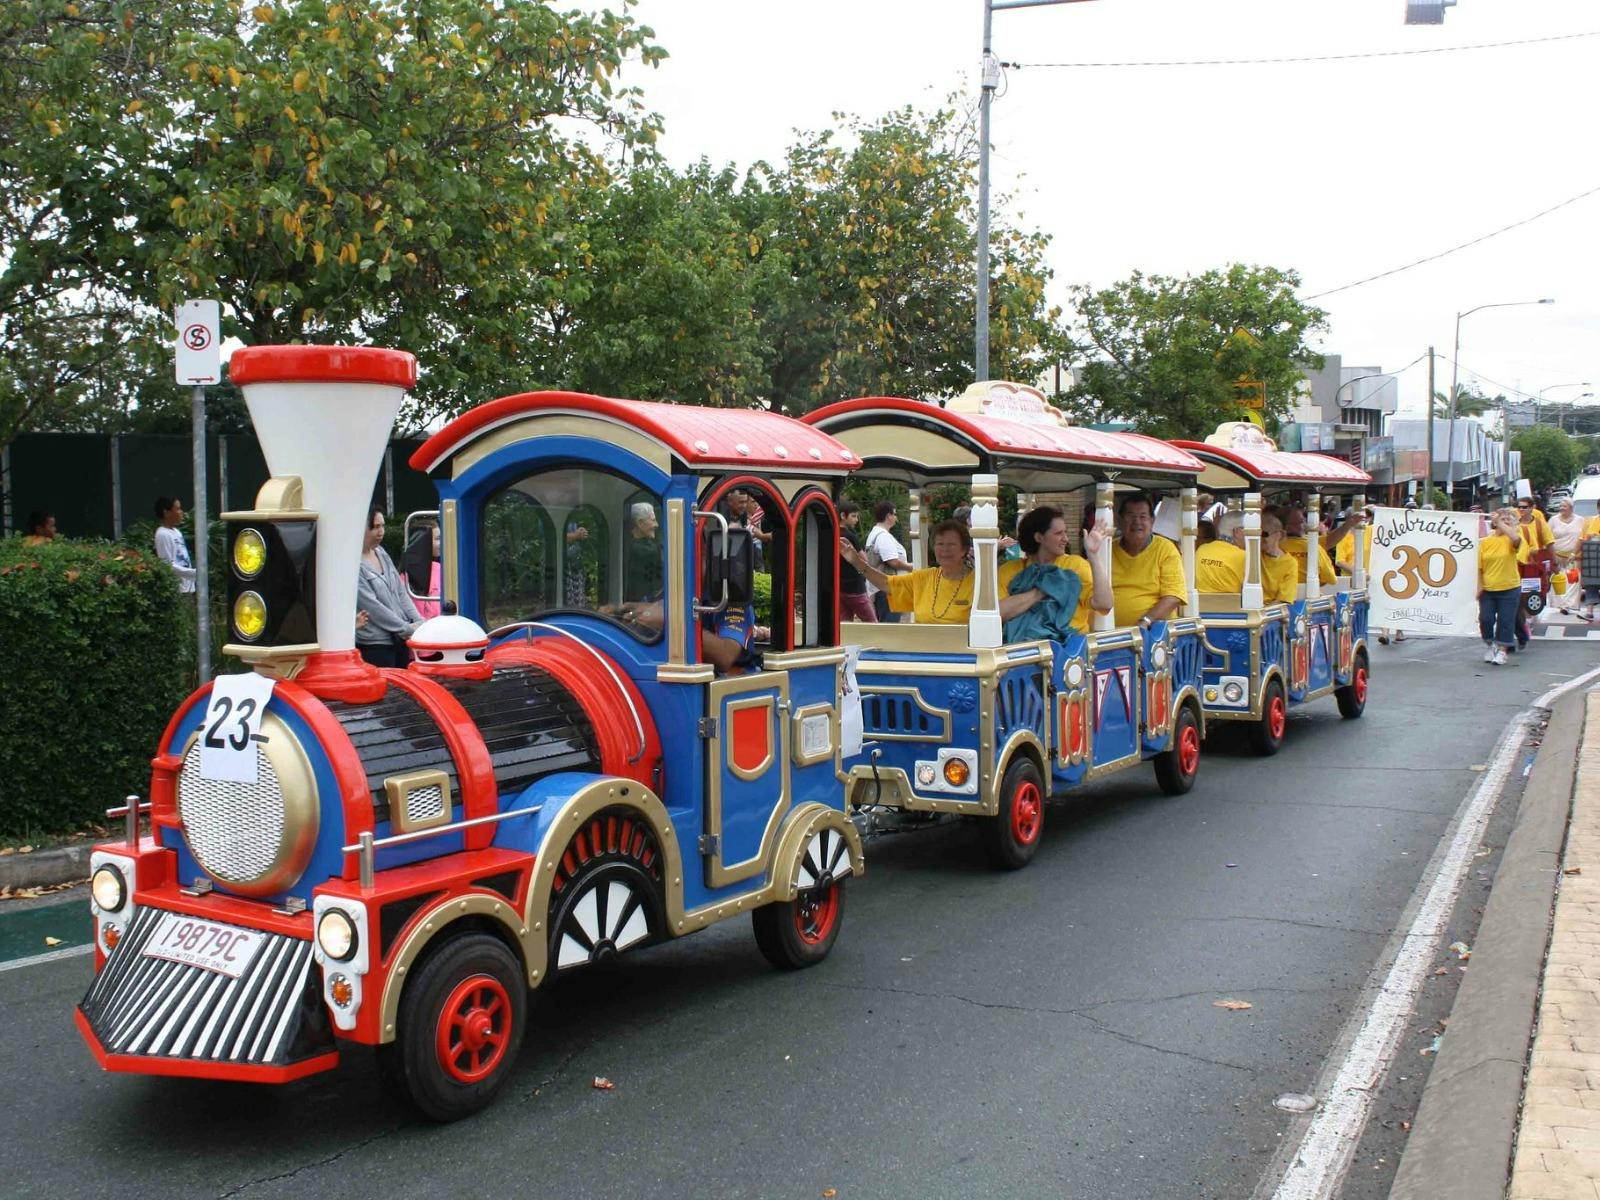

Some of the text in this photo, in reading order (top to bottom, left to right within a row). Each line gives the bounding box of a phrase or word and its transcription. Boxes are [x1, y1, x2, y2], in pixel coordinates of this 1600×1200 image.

[1373, 509, 1474, 553] Celebrating
[1200, 558, 1224, 568] RESPITE
[1382, 545, 1457, 600] 30
[205, 696, 257, 752] 23
[160, 920, 249, 962] 19879C
